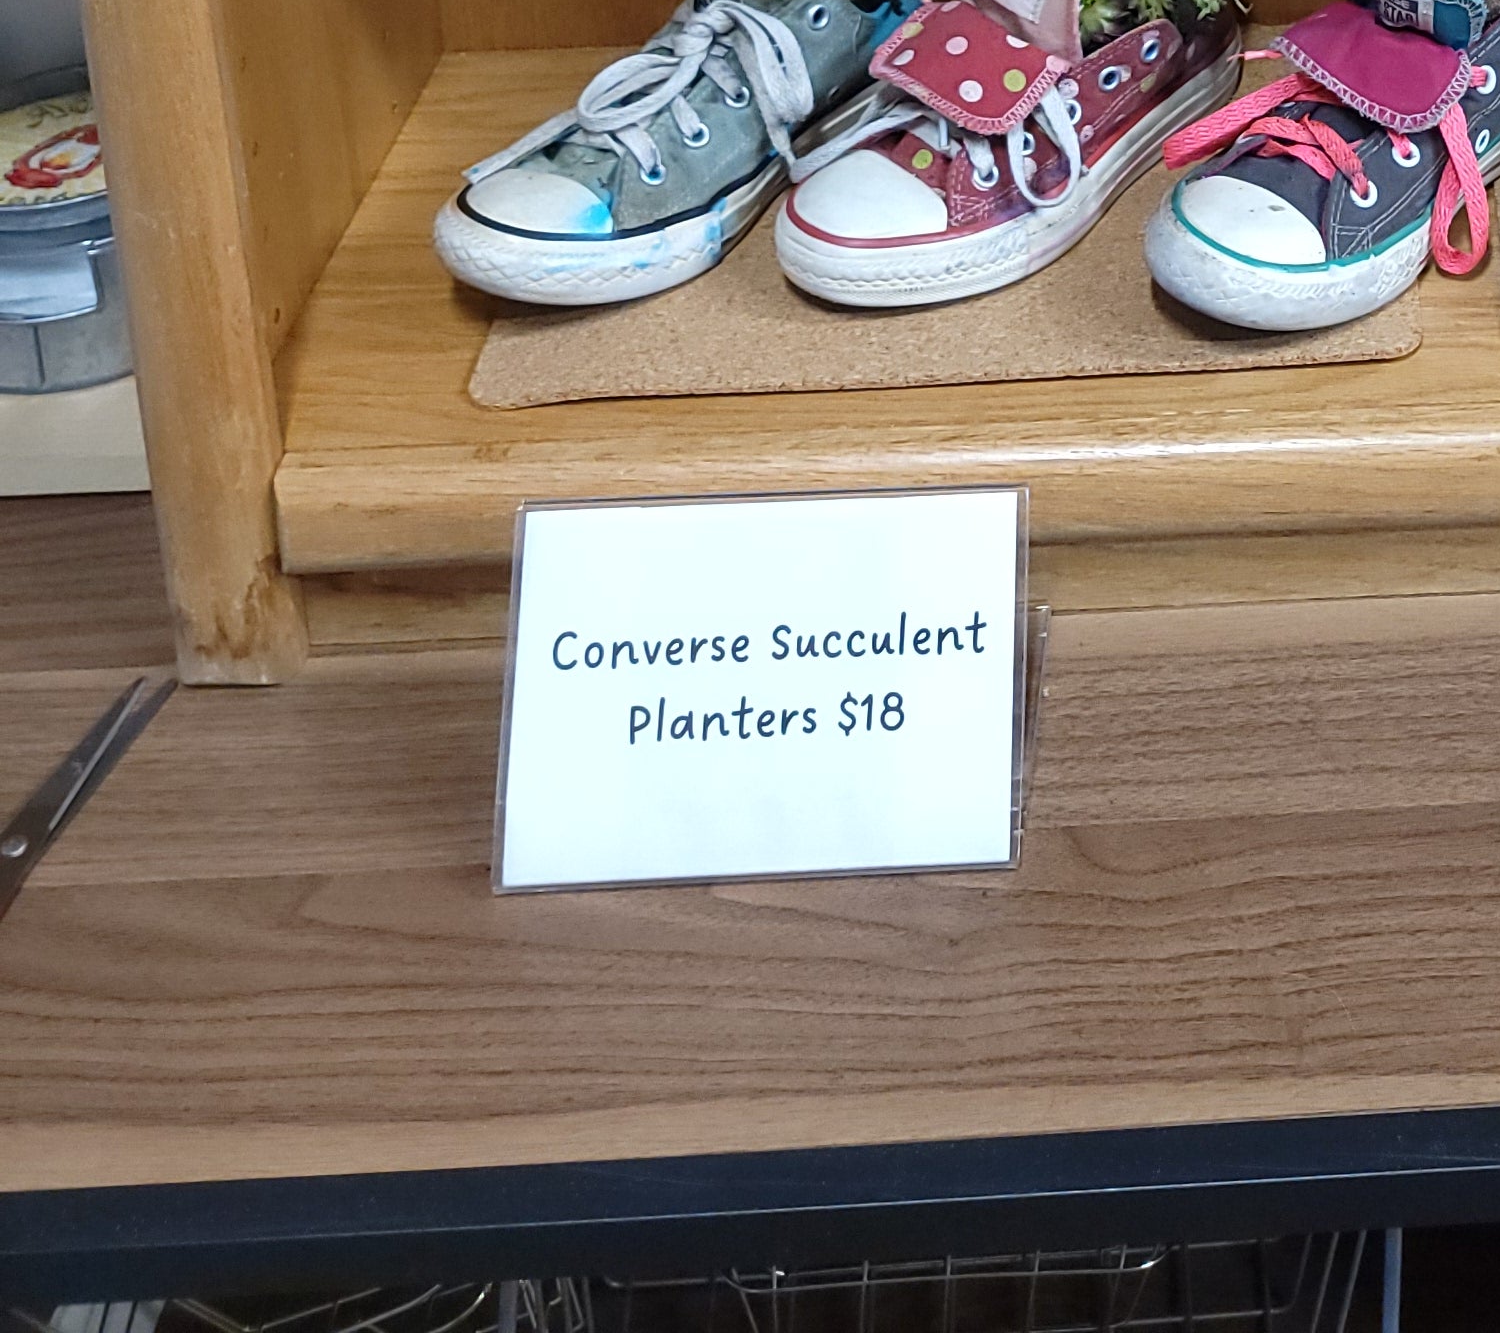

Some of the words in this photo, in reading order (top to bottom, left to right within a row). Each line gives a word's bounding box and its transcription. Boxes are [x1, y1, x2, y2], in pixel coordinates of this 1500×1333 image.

[553, 631, 750, 671] Converse
[771, 611, 987, 661] Succulent
[629, 696, 817, 745] Planters
[838, 691, 905, 737] $18
